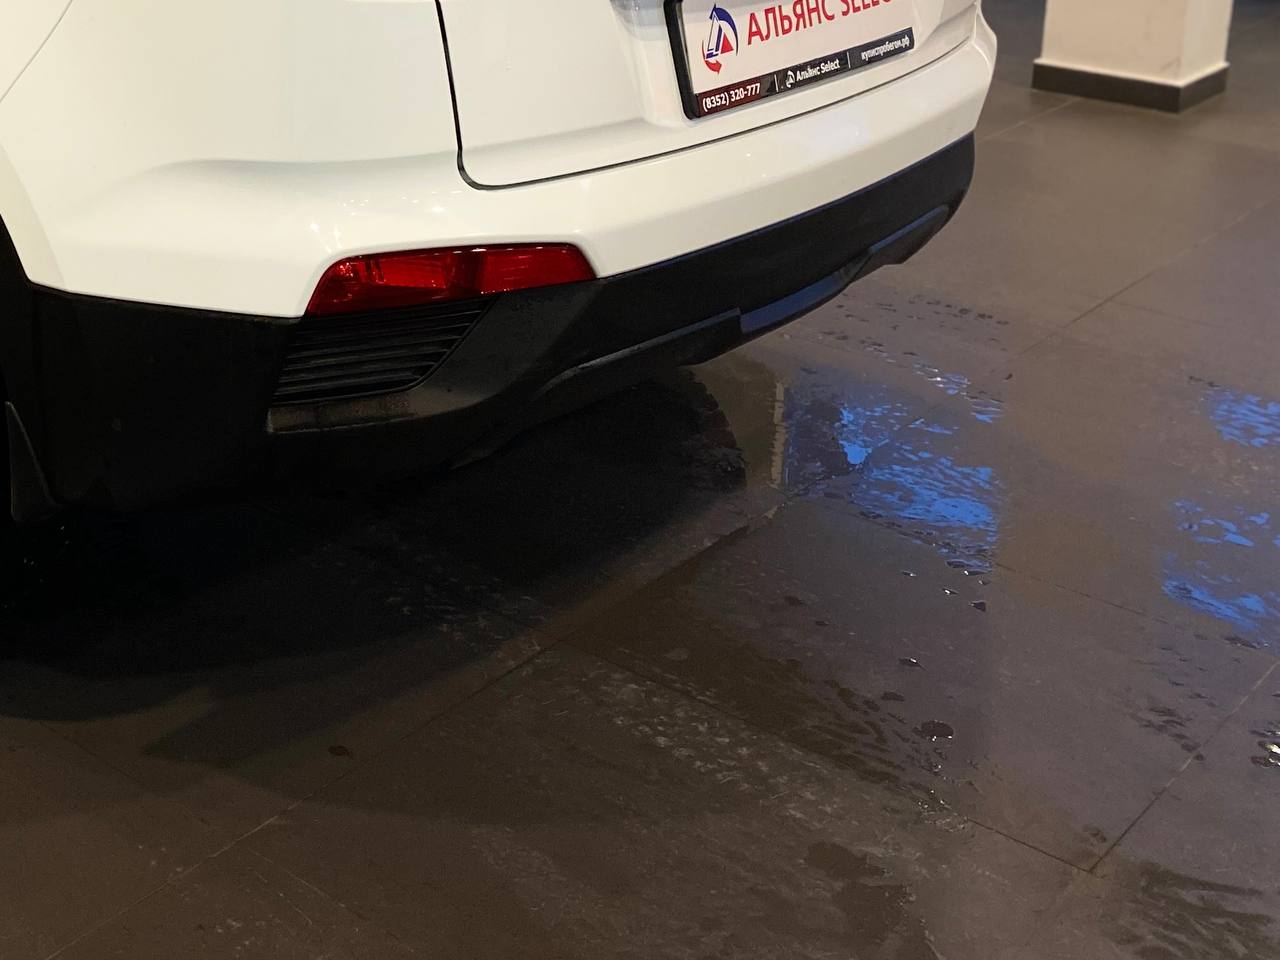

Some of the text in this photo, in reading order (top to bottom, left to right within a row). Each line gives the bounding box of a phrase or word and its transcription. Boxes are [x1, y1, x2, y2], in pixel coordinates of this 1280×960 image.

[796, 59, 840, 82] Альянс Select
[702, 83, 760, 112] (8352) 320-777
